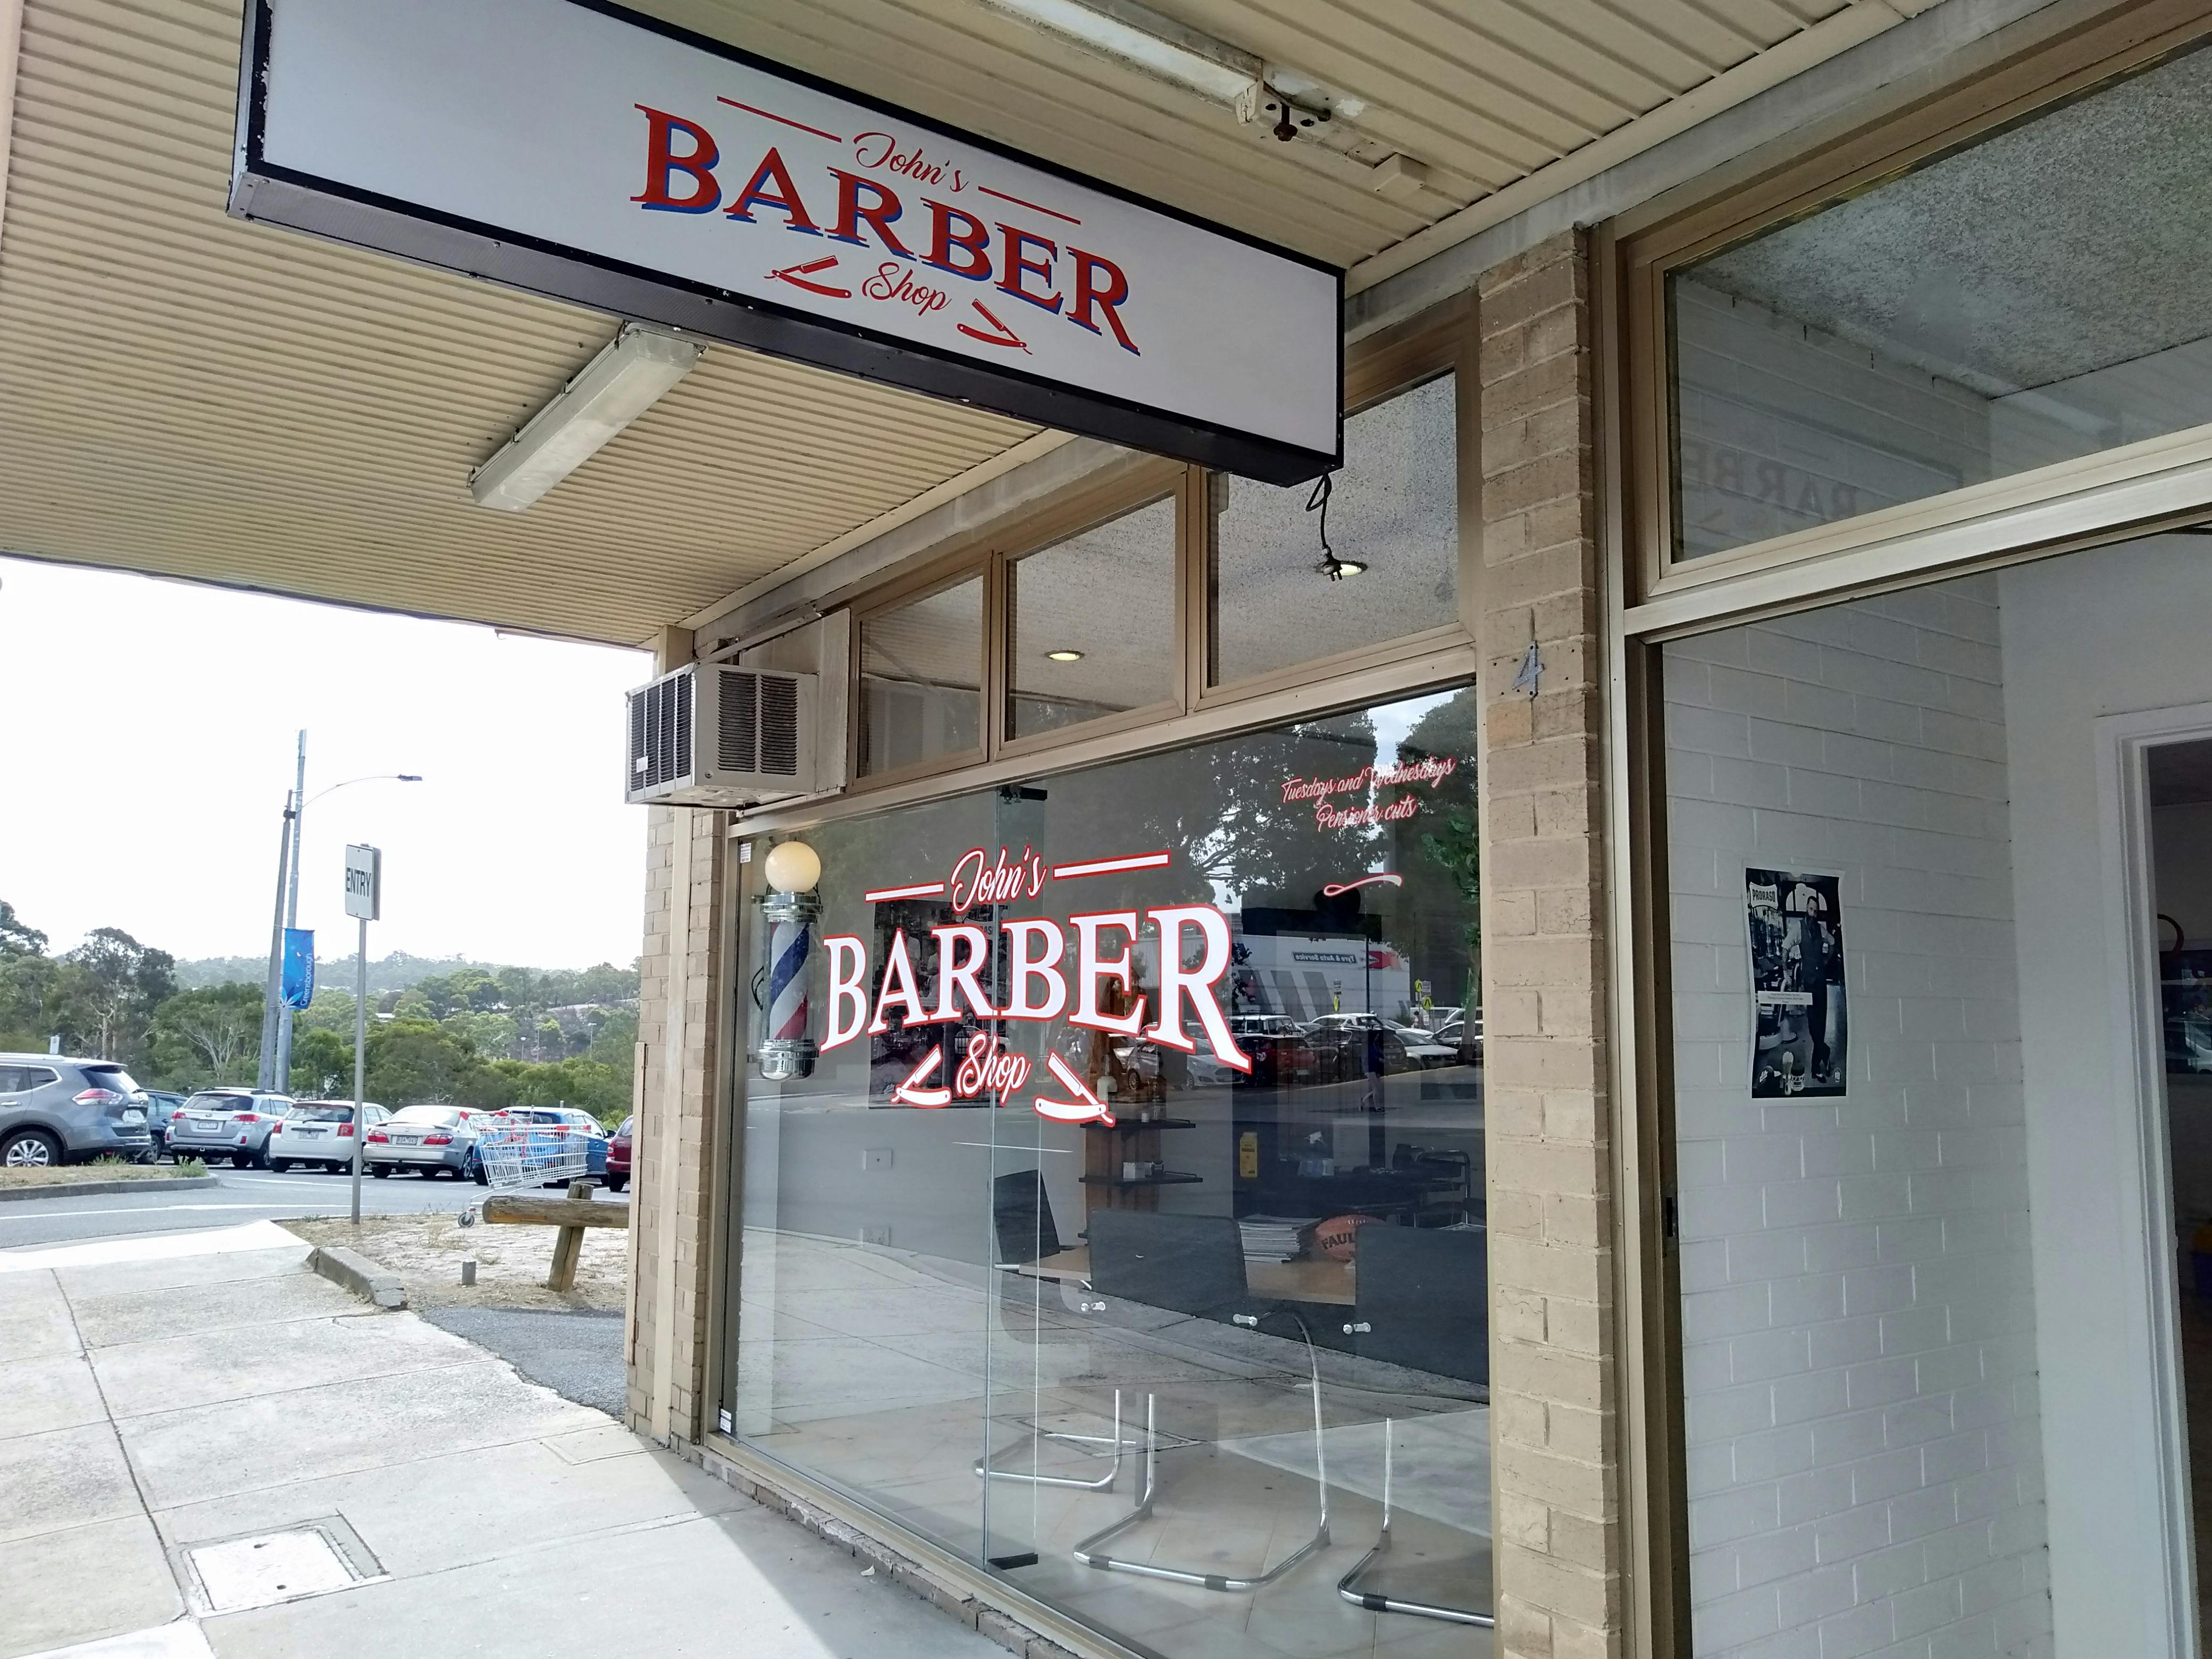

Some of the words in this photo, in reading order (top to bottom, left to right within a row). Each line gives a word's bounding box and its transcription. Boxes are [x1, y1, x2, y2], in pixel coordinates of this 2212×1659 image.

[853, 131, 968, 192] John's
[630, 103, 1141, 357] BARBER
[861, 262, 952, 317] Shop
[1512, 640, 1544, 697] 4
[1281, 777, 1337, 806] Tuesdays
[1337, 768, 1364, 792] and
[1364, 755, 1456, 789] Wednesdays
[1316, 803, 1383, 833] Pensioner
[1384, 793, 1417, 821] cuts
[346, 867, 371, 897] ENTRY
[950, 845, 1047, 915] John's
[1752, 889, 1775, 902] PRORASO
[300, 953, 312, 1006] Greensborough
[820, 903, 1252, 1074] BARBER
[956, 1030, 1032, 1107] Shop
